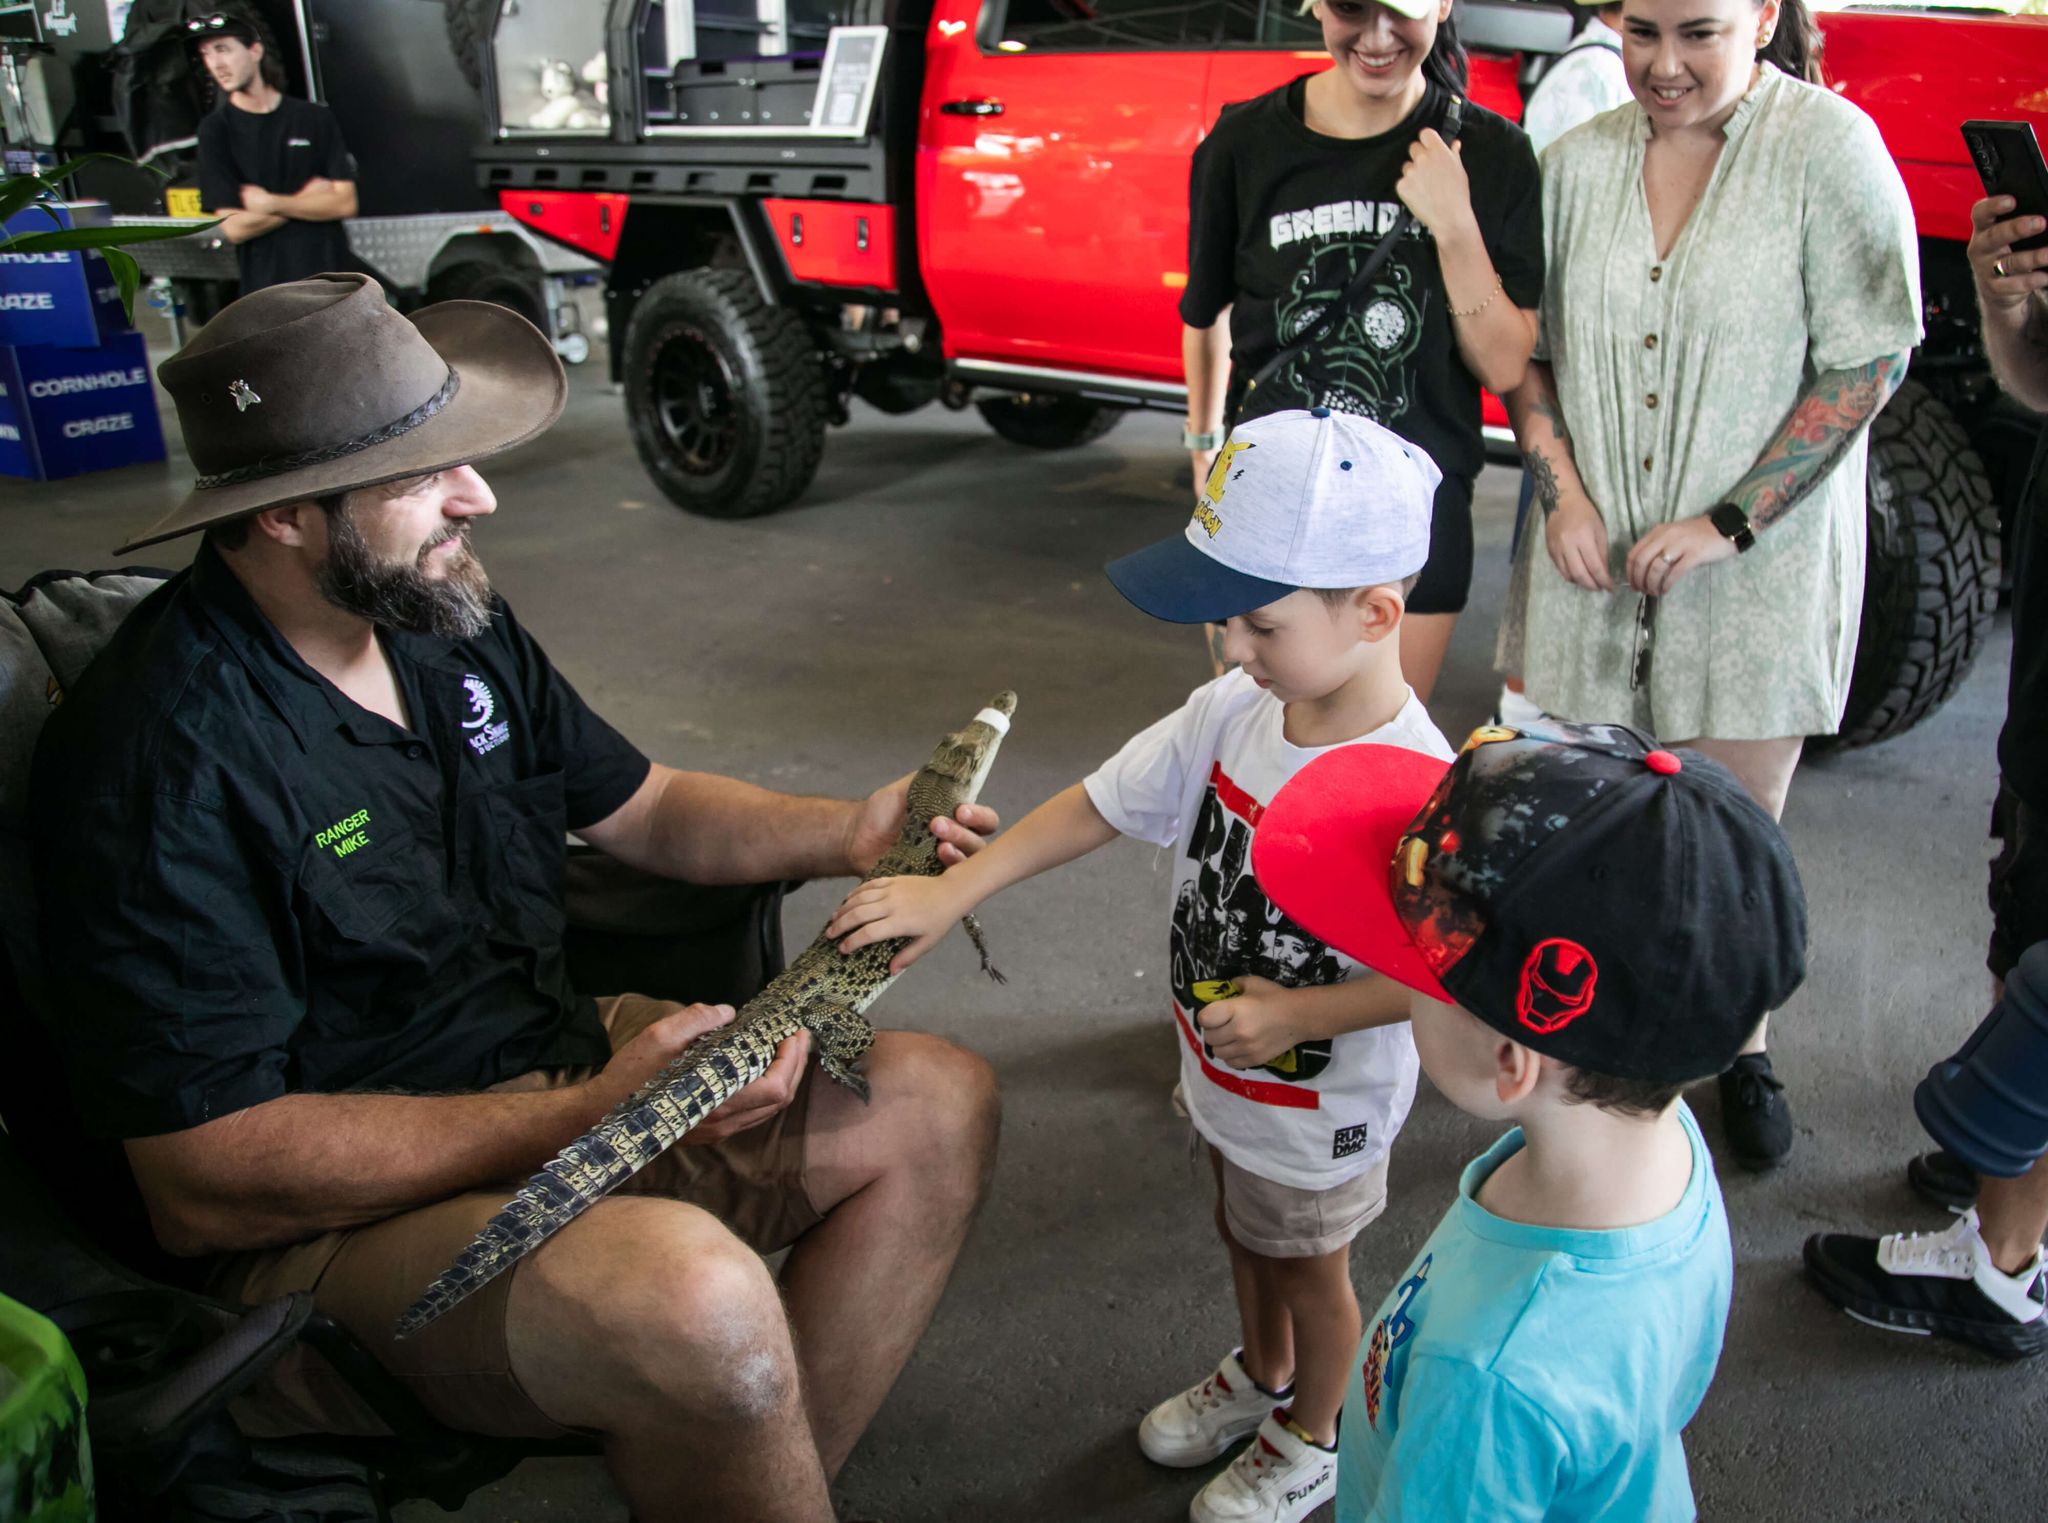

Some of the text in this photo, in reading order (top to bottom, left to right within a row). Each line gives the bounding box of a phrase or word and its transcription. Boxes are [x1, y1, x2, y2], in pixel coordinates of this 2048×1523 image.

[1270, 200, 1375, 250] GREEN
[30, 367, 147, 398] CORNHOLE
[63, 413, 134, 438] CRAZE
[315, 809, 371, 848] RANGER
[333, 830, 370, 858] MIKE
[1333, 1138, 1366, 1156] DMC
[1335, 1126, 1367, 1145] RUN
[1286, 1471, 1330, 1506] PUMA
